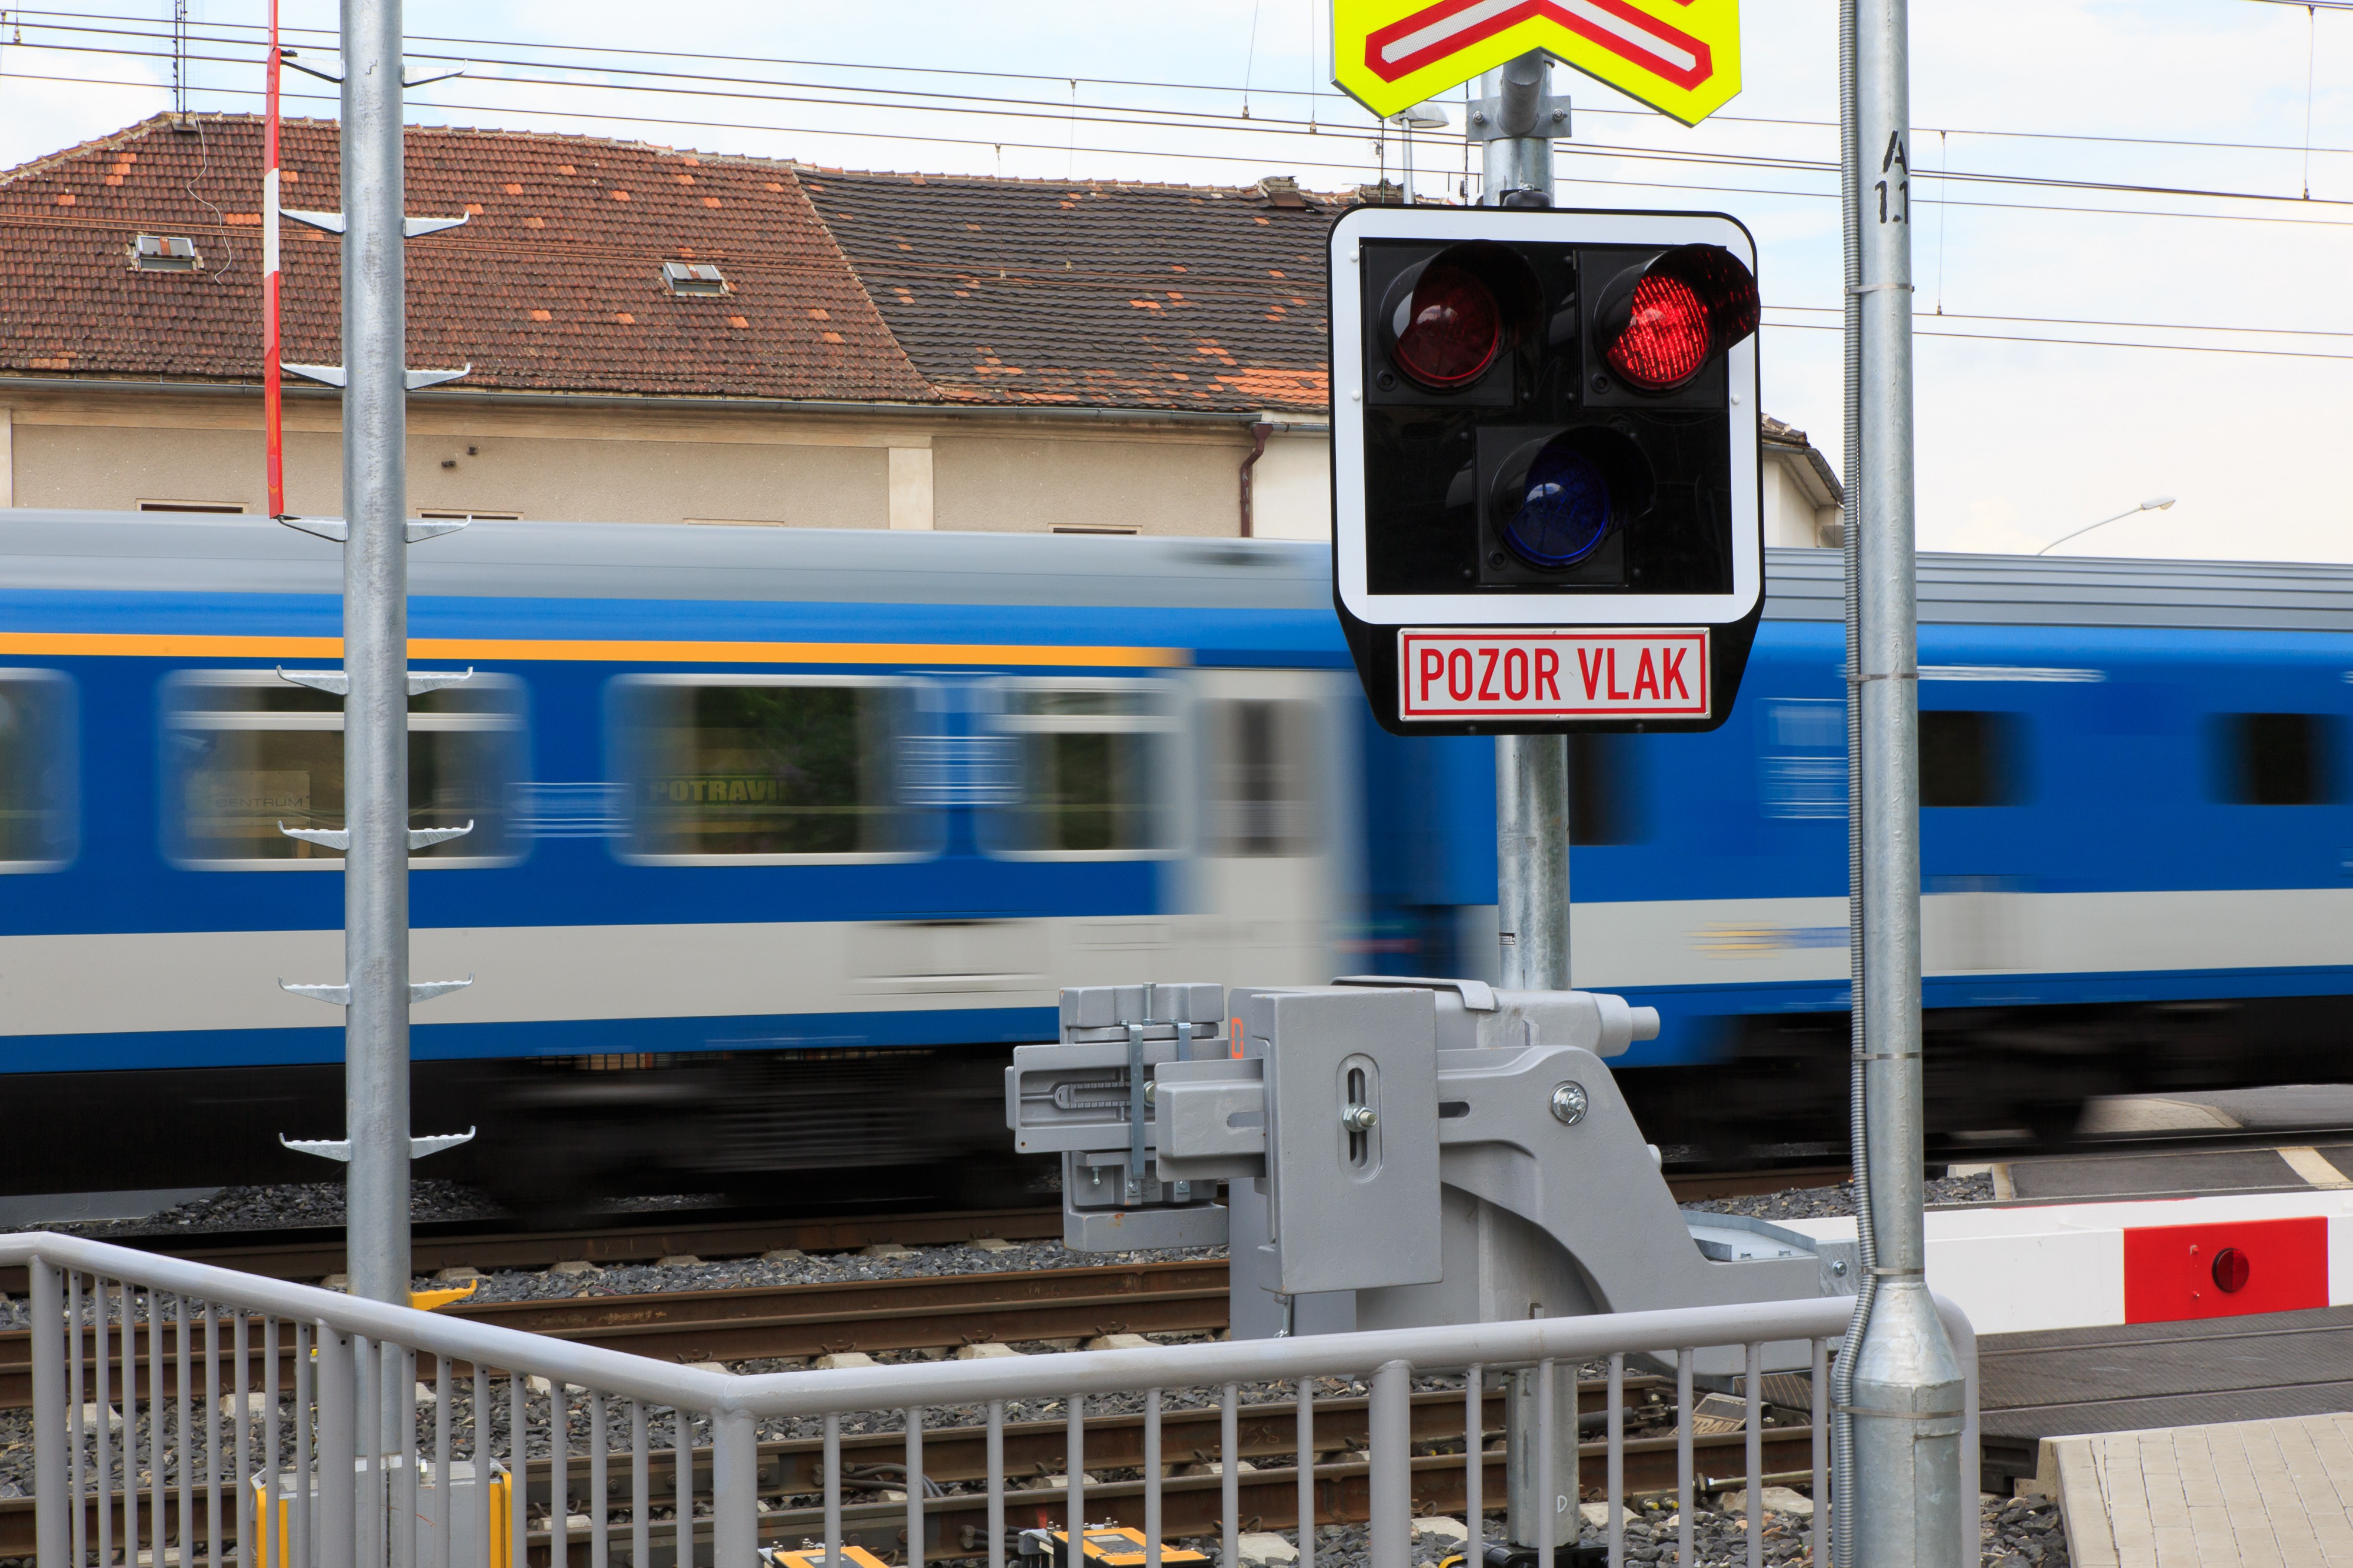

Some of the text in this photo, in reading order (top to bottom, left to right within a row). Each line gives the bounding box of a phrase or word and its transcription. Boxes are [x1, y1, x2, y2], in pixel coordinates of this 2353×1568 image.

[1882, 131, 1908, 175] A
[1421, 648, 1689, 701] POZOR VLAK
[216, 798, 302, 808] CENTRUM
